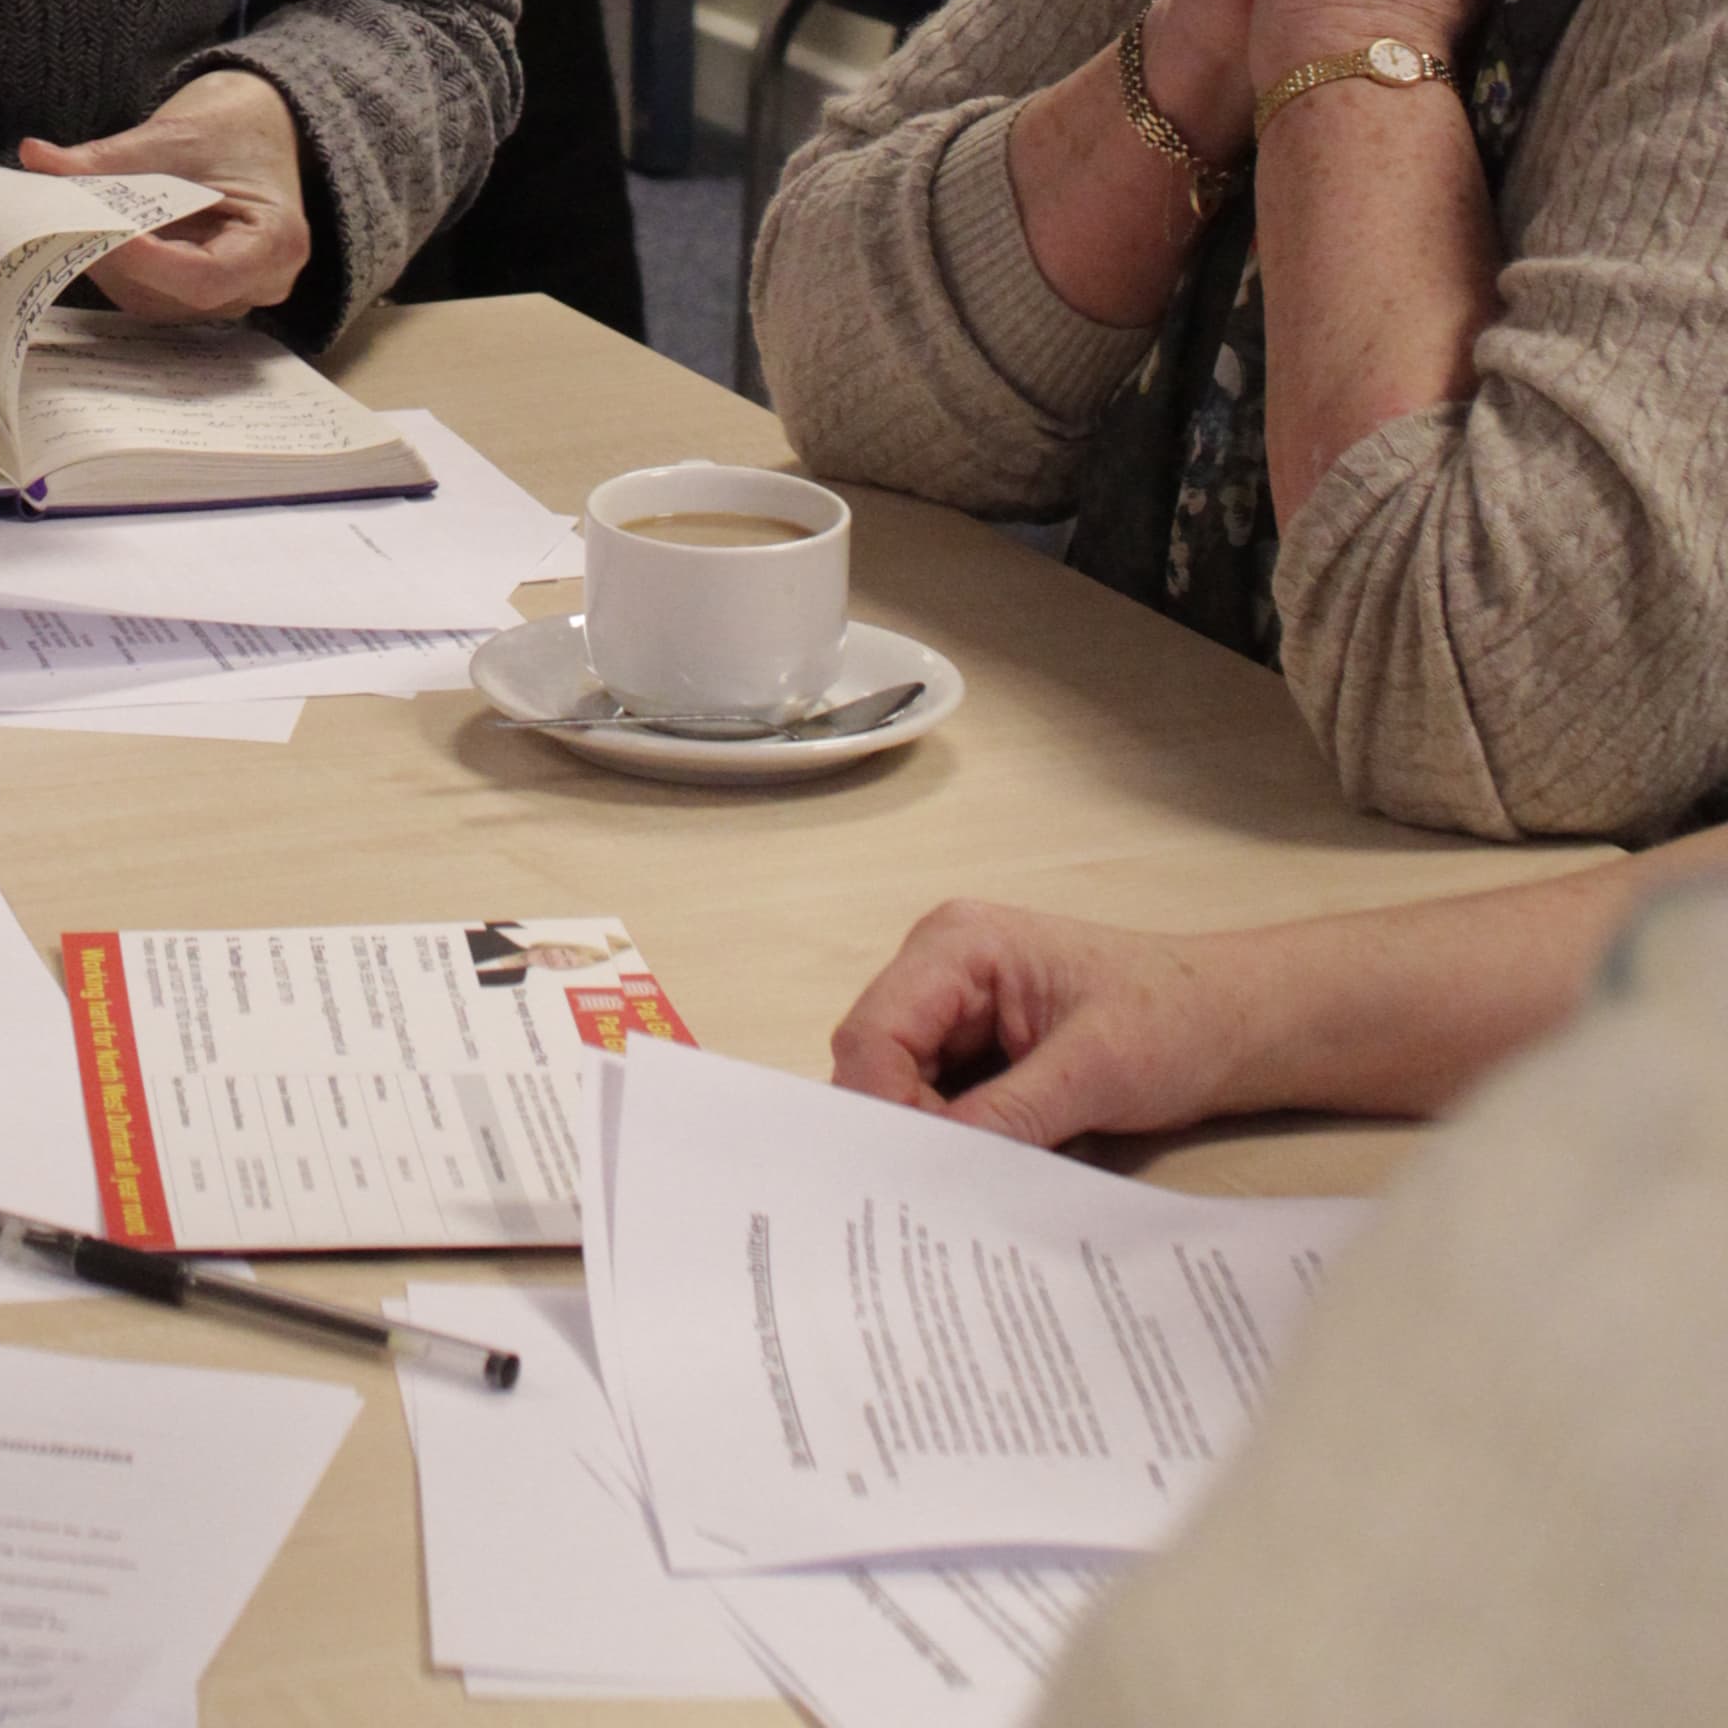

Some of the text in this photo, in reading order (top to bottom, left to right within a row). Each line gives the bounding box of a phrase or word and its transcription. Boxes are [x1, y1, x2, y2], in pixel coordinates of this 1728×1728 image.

[80, 947, 107, 1000] Working
[88, 1000, 115, 1030] hard
[93, 1029, 117, 1049] for
[96, 1049, 123, 1082] North
[103, 1082, 129, 1116] West
[107, 1114, 135, 1160] Durham
[115, 1159, 141, 1178] all
[110, 1175, 139, 1204] year
